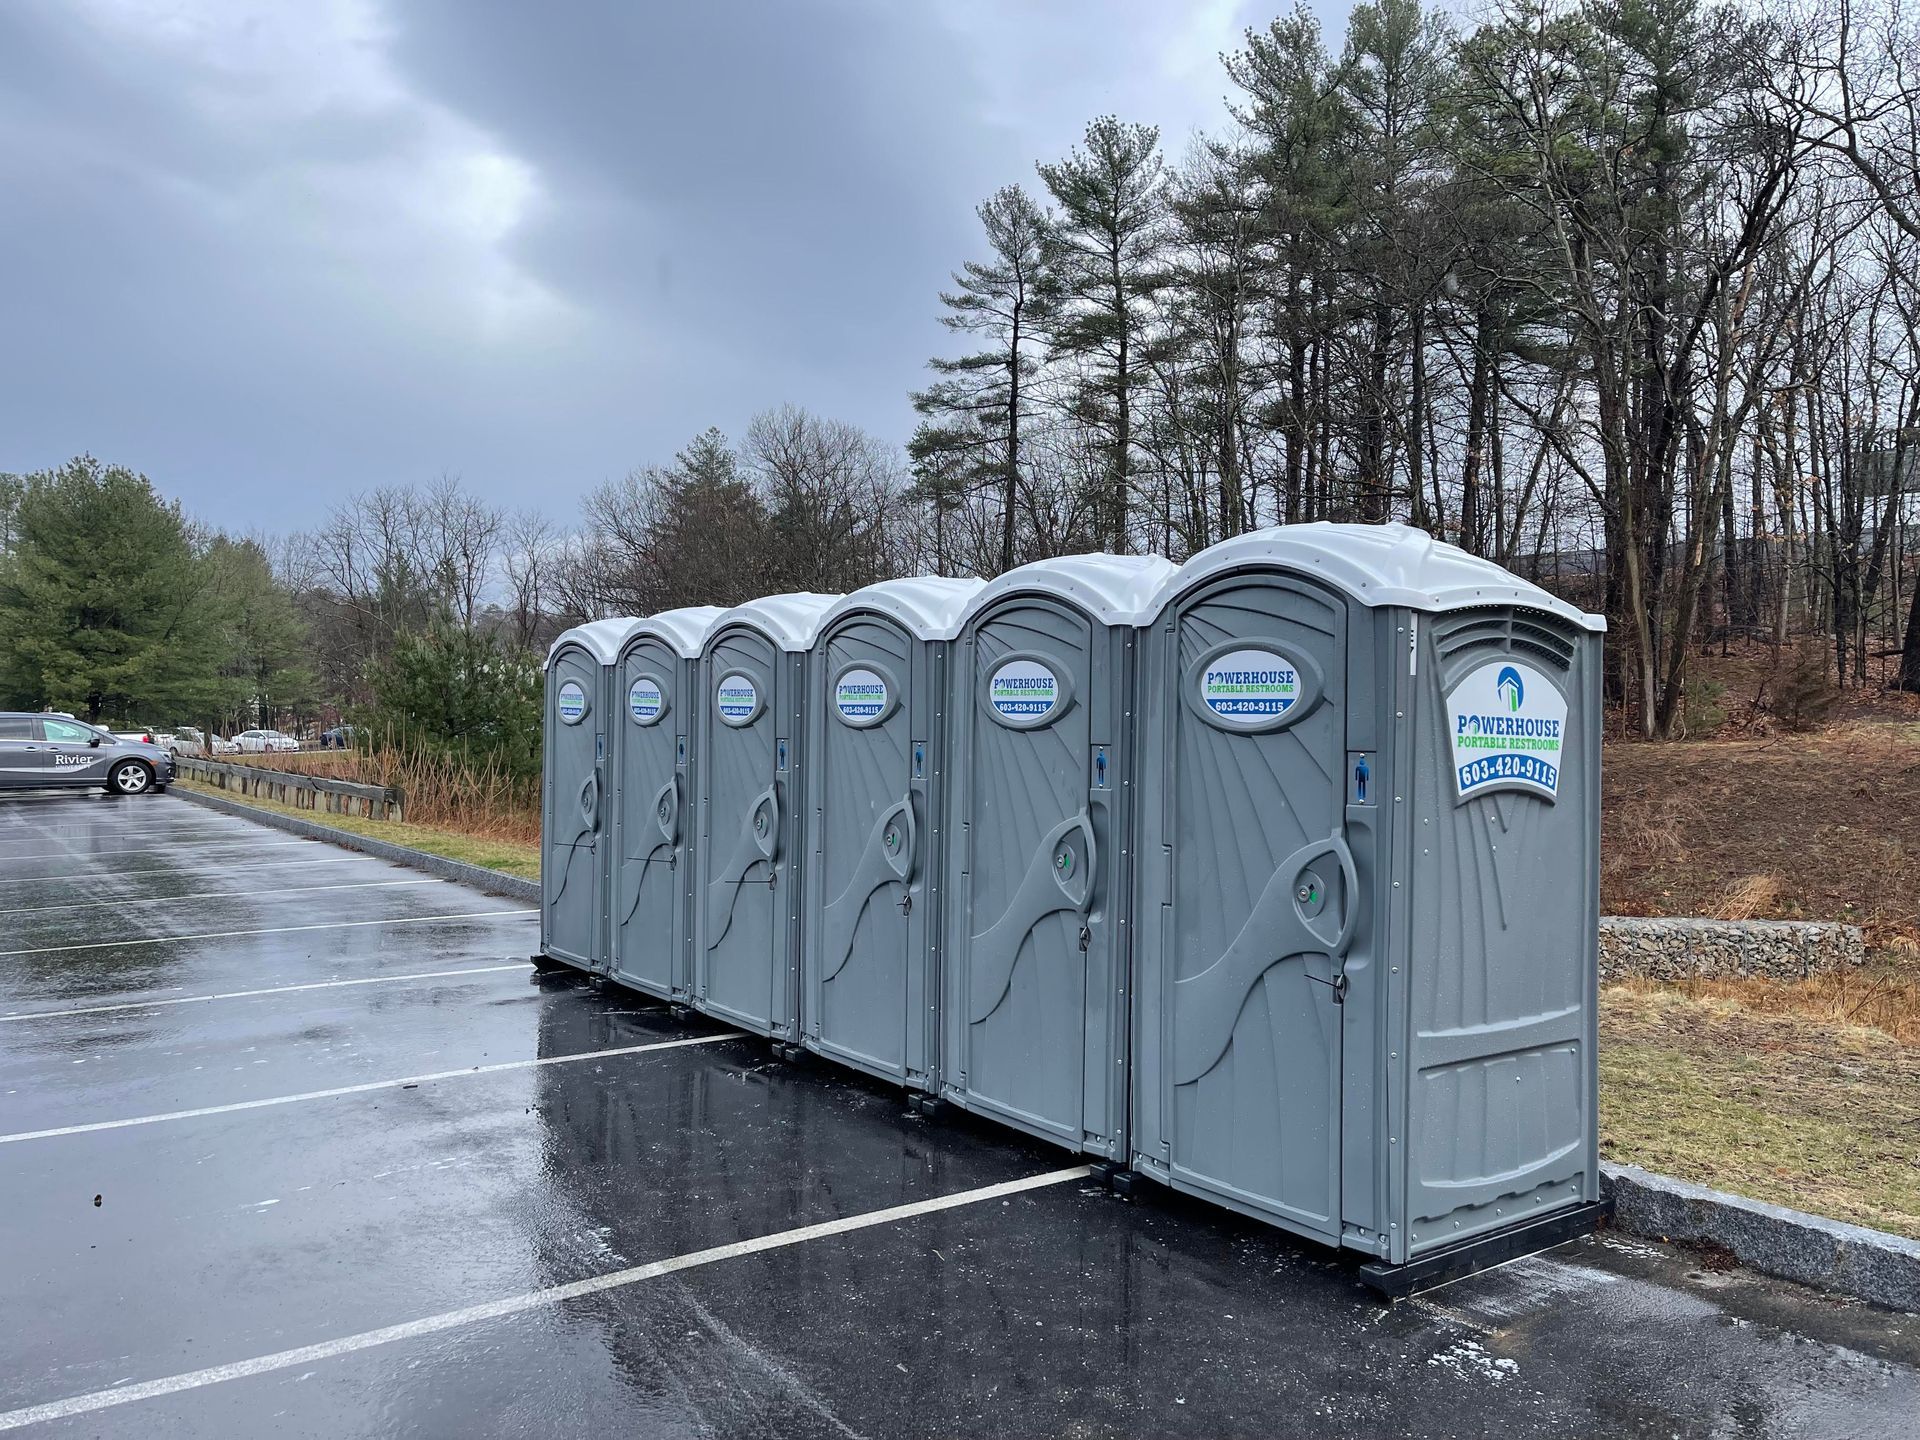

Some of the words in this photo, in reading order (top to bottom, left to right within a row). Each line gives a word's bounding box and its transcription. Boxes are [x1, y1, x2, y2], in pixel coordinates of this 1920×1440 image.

[1207, 671, 1294, 684] POWERHOUSE
[994, 678, 1054, 689] POWERHOUSE
[1207, 685, 1244, 693] PORTABLE
[1245, 684, 1294, 693] RESTROOMS
[999, 703, 1047, 712] 603-420-9115
[1215, 702, 1284, 711] 603-420-9115
[1457, 715, 1560, 738] POWERHOUSE
[1457, 736, 1507, 749] PORTABLE
[1509, 737, 1560, 751] RESTROOMS
[55, 754, 94, 765] Rivier
[1462, 757, 1556, 786] 603-420-9115
